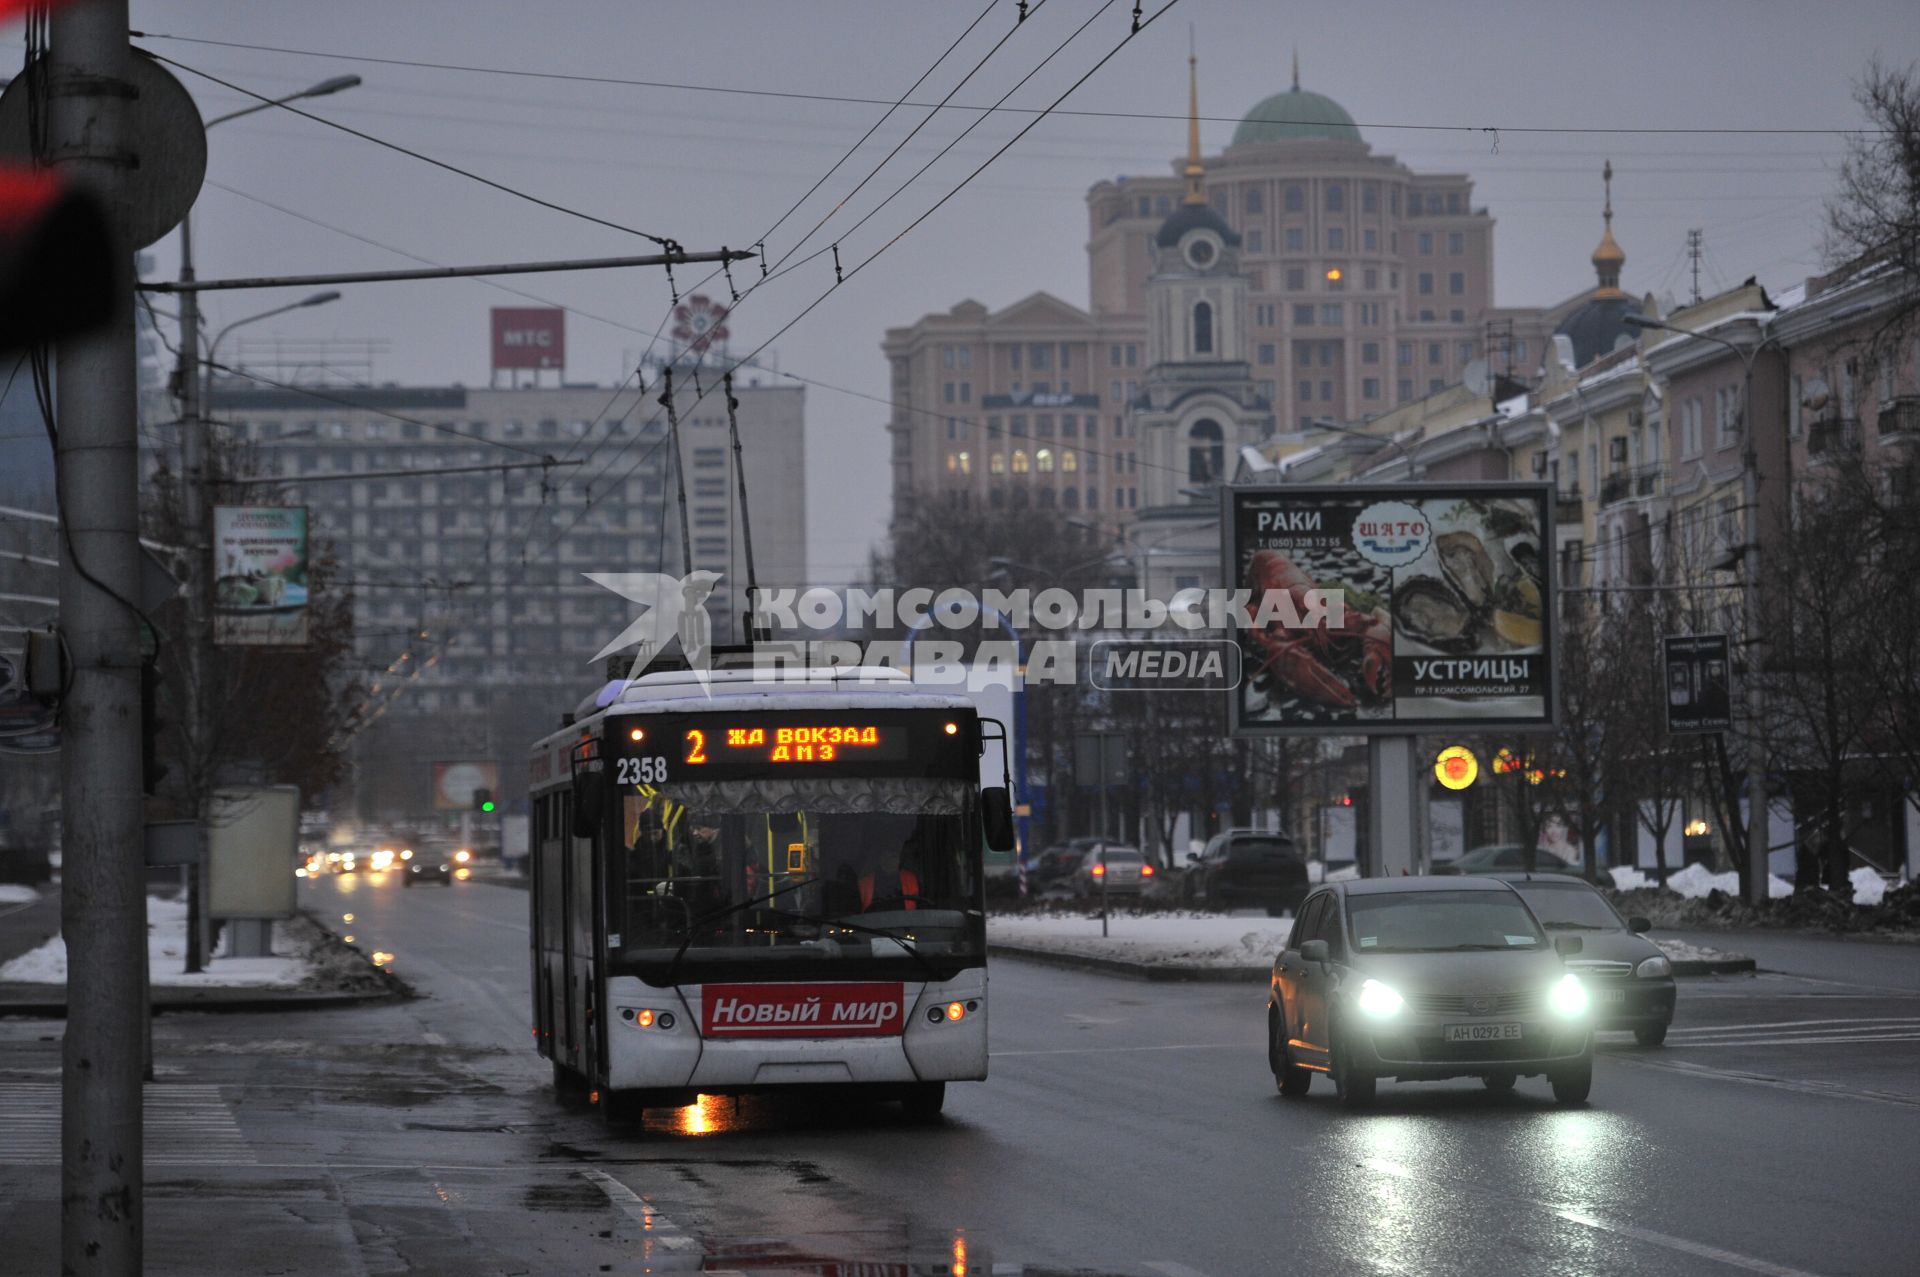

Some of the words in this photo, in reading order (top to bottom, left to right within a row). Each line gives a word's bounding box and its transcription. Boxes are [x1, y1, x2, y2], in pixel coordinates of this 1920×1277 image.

[504, 329, 552, 347] МТС
[1258, 511, 1322, 532] РАКИ
[1359, 521, 1425, 537] ШАТО
[1269, 537, 1294, 549] (050)
[1315, 537, 1327, 547] 12
[1329, 537, 1341, 547] 55
[1413, 659, 1529, 683] УСТРИЦЫ
[1519, 685, 1530, 694] 27
[728, 728, 764, 745] ЖД
[686, 730, 707, 765] 2
[617, 756, 668, 785] 2358
[712, 997, 821, 1023] Новый
[831, 1001, 899, 1028] мир
[1472, 1026, 1500, 1039] 0292
[1504, 1024, 1519, 1038] EE
